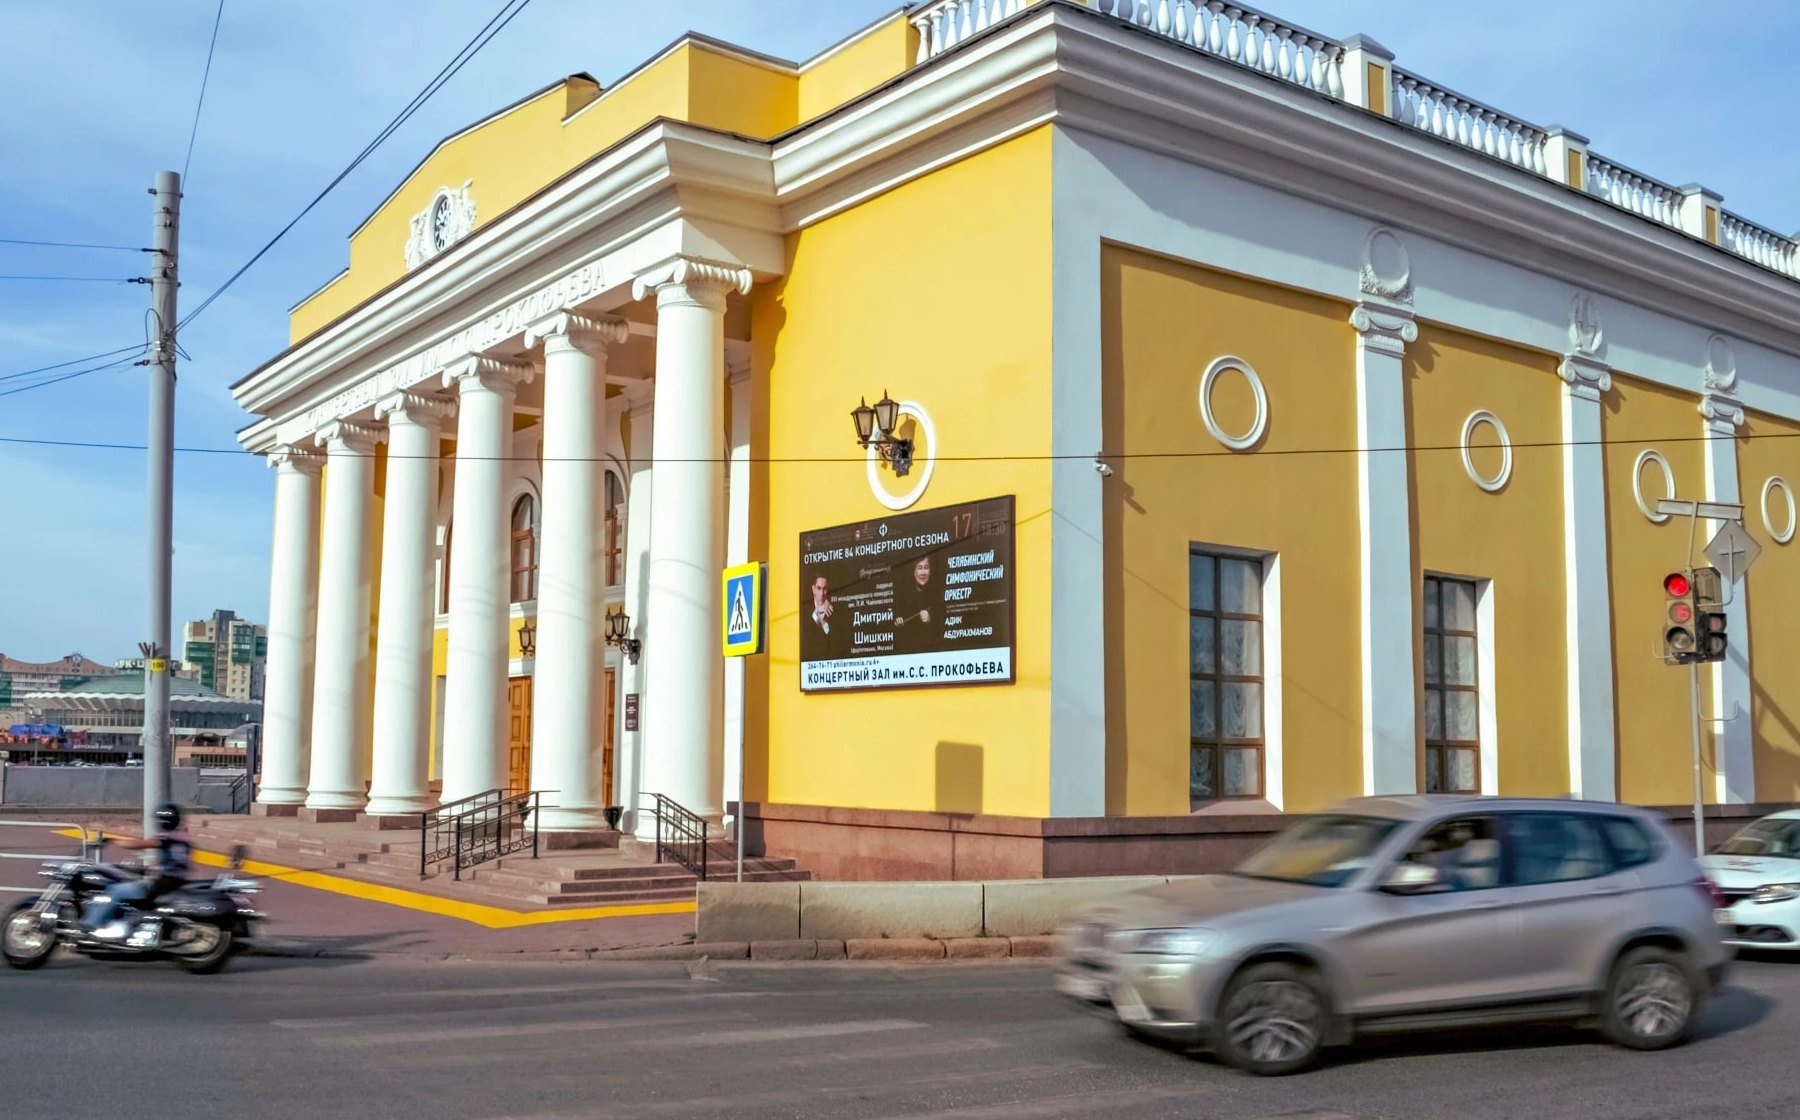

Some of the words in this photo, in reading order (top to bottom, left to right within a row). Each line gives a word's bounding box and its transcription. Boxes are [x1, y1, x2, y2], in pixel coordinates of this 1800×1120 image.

[952, 513, 973, 538] 17
[804, 548, 844, 565] ОТКРЫТИЕ
[845, 547, 854, 558] 84
[855, 538, 913, 557] КОНЦЕРТНОГО
[915, 532, 949, 546] СЕЗОНА
[947, 549, 994, 568] ЧЕЛЯБИНСКИЙ
[945, 564, 1004, 585] СИМФОНИЧЕСКИЙ
[944, 587, 972, 601] ОРКЕСТР
[853, 608, 893, 627] Дмитрий
[945, 615, 962, 626] АДИК
[854, 631, 893, 644] Шишкин
[944, 627, 993, 640] АБДУРАХМАНОВ
[808, 668, 869, 684] КОНЦЕРТНЫЙ
[872, 668, 890, 680] ЗАЛ
[931, 662, 1004, 677] ПРОКОФЬЕВА
